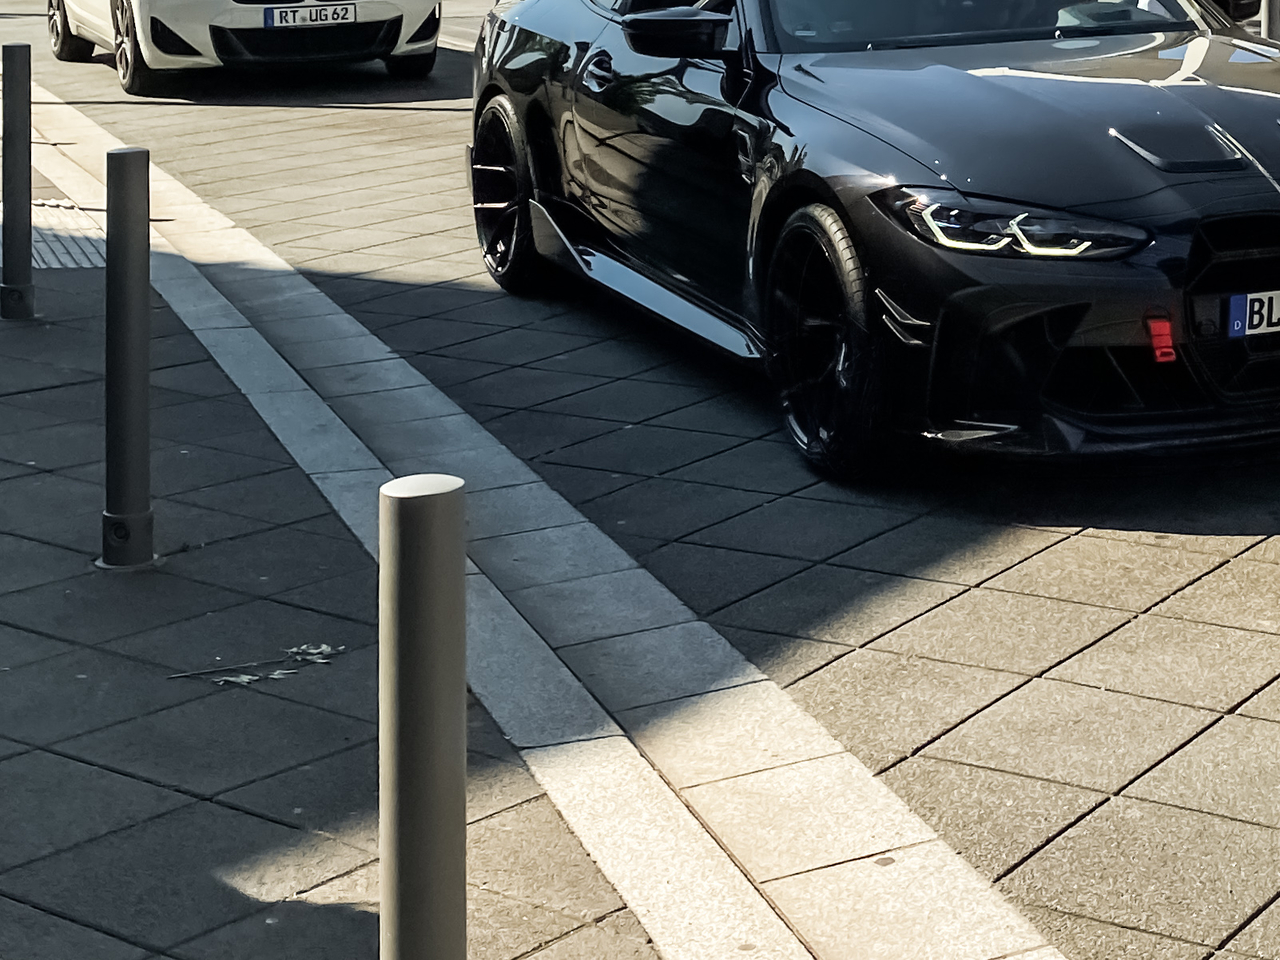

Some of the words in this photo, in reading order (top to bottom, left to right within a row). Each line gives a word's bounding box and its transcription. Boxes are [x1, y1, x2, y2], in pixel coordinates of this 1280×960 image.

[279, 9, 300, 24] RT
[309, 7, 328, 23] UG
[331, 6, 349, 21] 62
